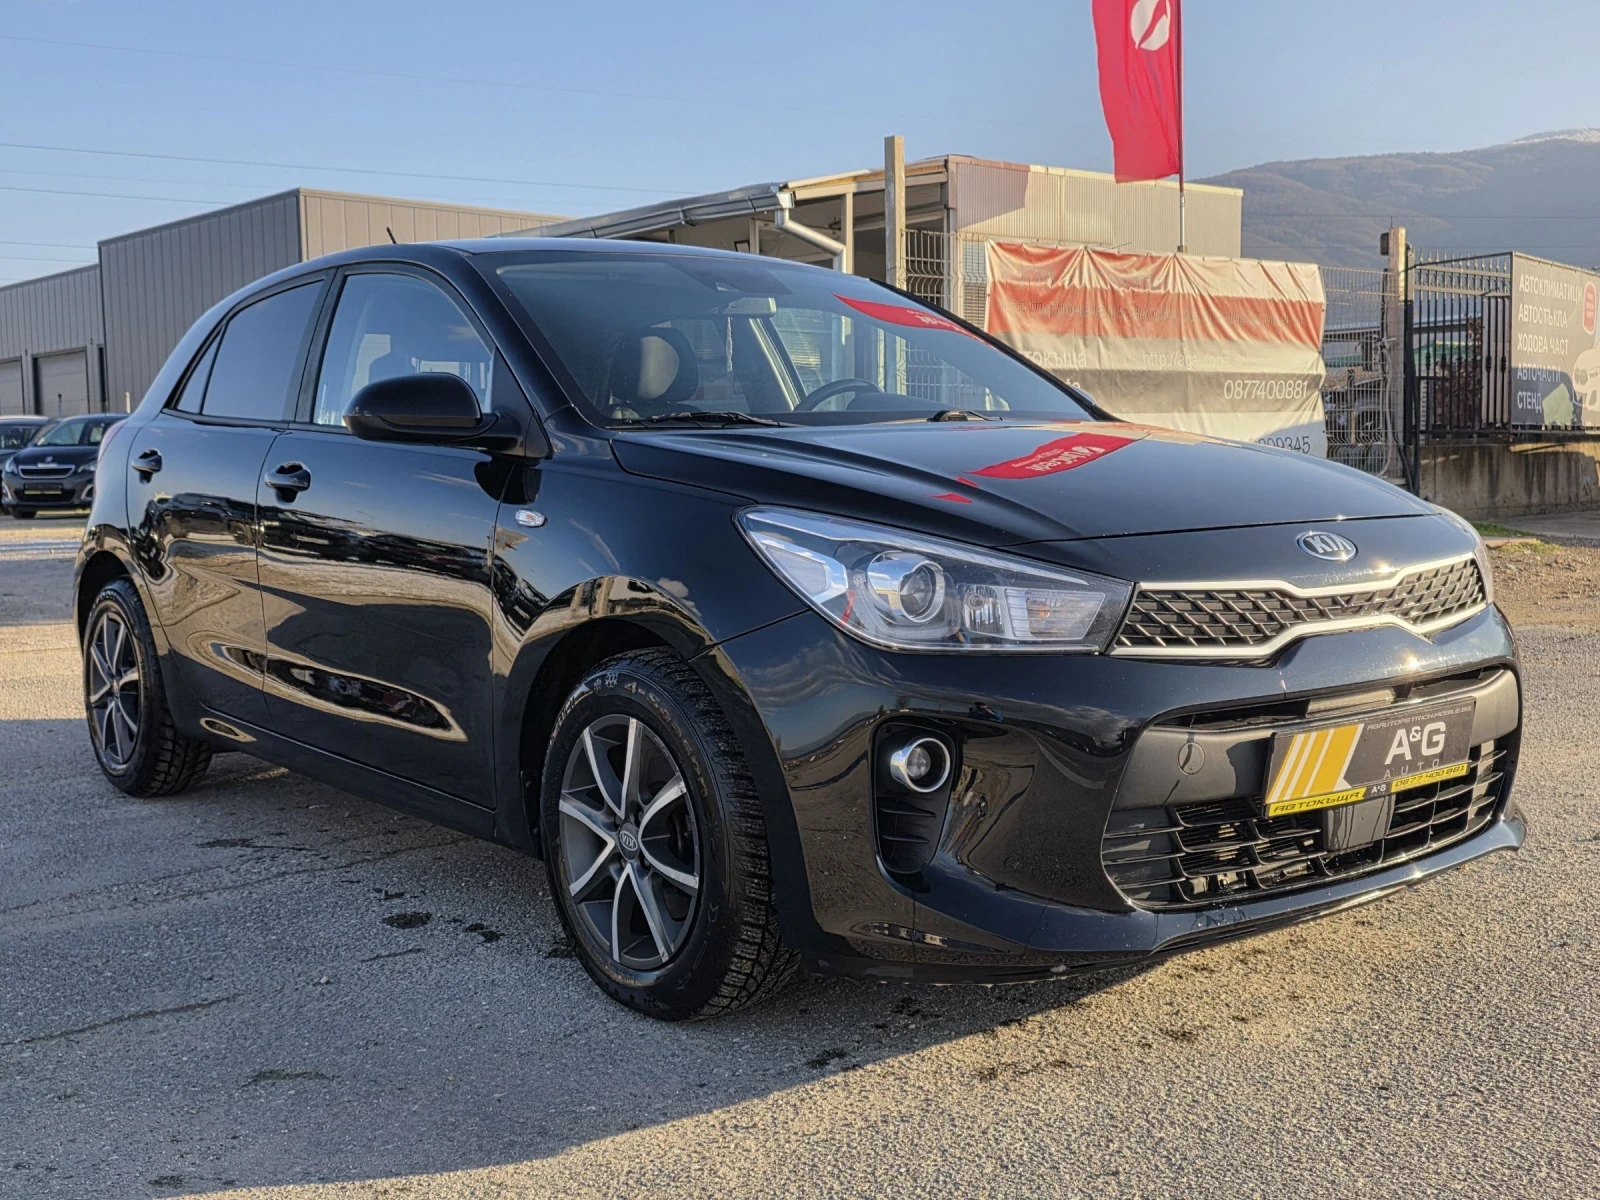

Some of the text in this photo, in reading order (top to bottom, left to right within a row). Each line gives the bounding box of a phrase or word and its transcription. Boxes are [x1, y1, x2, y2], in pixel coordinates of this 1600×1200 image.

[1518, 273, 1583, 304] АВТОКЛИМАТИЦИ
[1517, 302, 1568, 328] АВТОСТЪКЛА
[1517, 332, 1569, 357] ХОДОВА ЧАСТ
[1517, 362, 1561, 383] АВТОЧАСТИ
[1224, 379, 1308, 400] 0877400881
[1517, 391, 1542, 413] СТЕНД
[1305, 534, 1352, 553] KIA
[1384, 721, 1446, 765] A&G
[1383, 758, 1440, 780] AUTO
[1395, 765, 1465, 787] 0877 400 881
